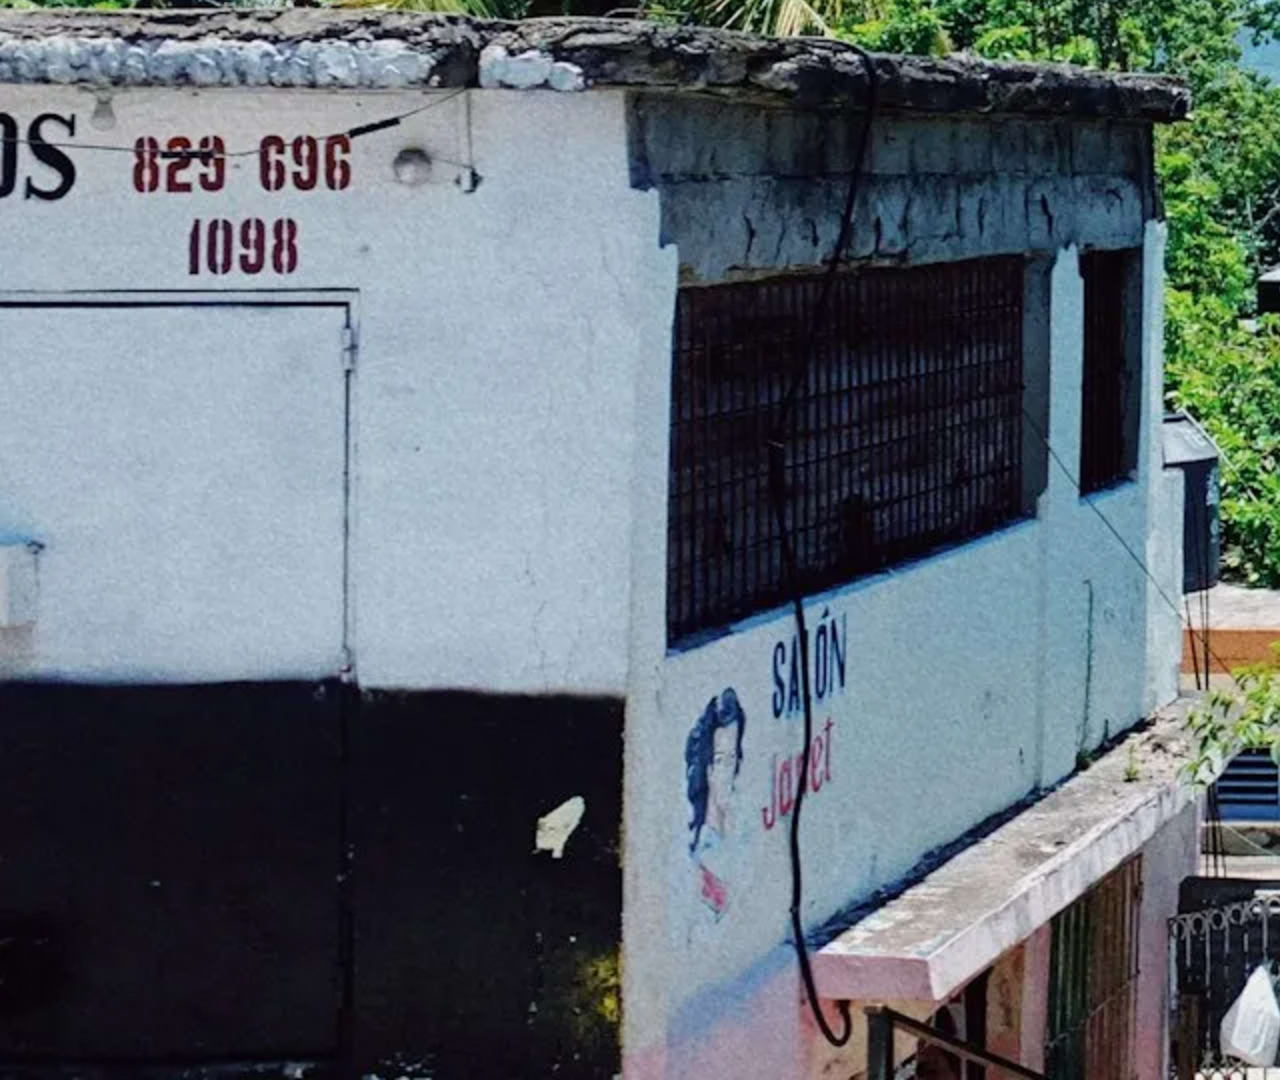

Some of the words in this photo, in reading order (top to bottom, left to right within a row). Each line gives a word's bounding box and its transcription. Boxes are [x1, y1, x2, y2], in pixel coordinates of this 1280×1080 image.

[0, 113, 76, 201] S
[134, 135, 225, 193] 829
[260, 135, 351, 191] 696
[188, 218, 298, 275] 1098
[772, 606, 847, 720] SAÓN
